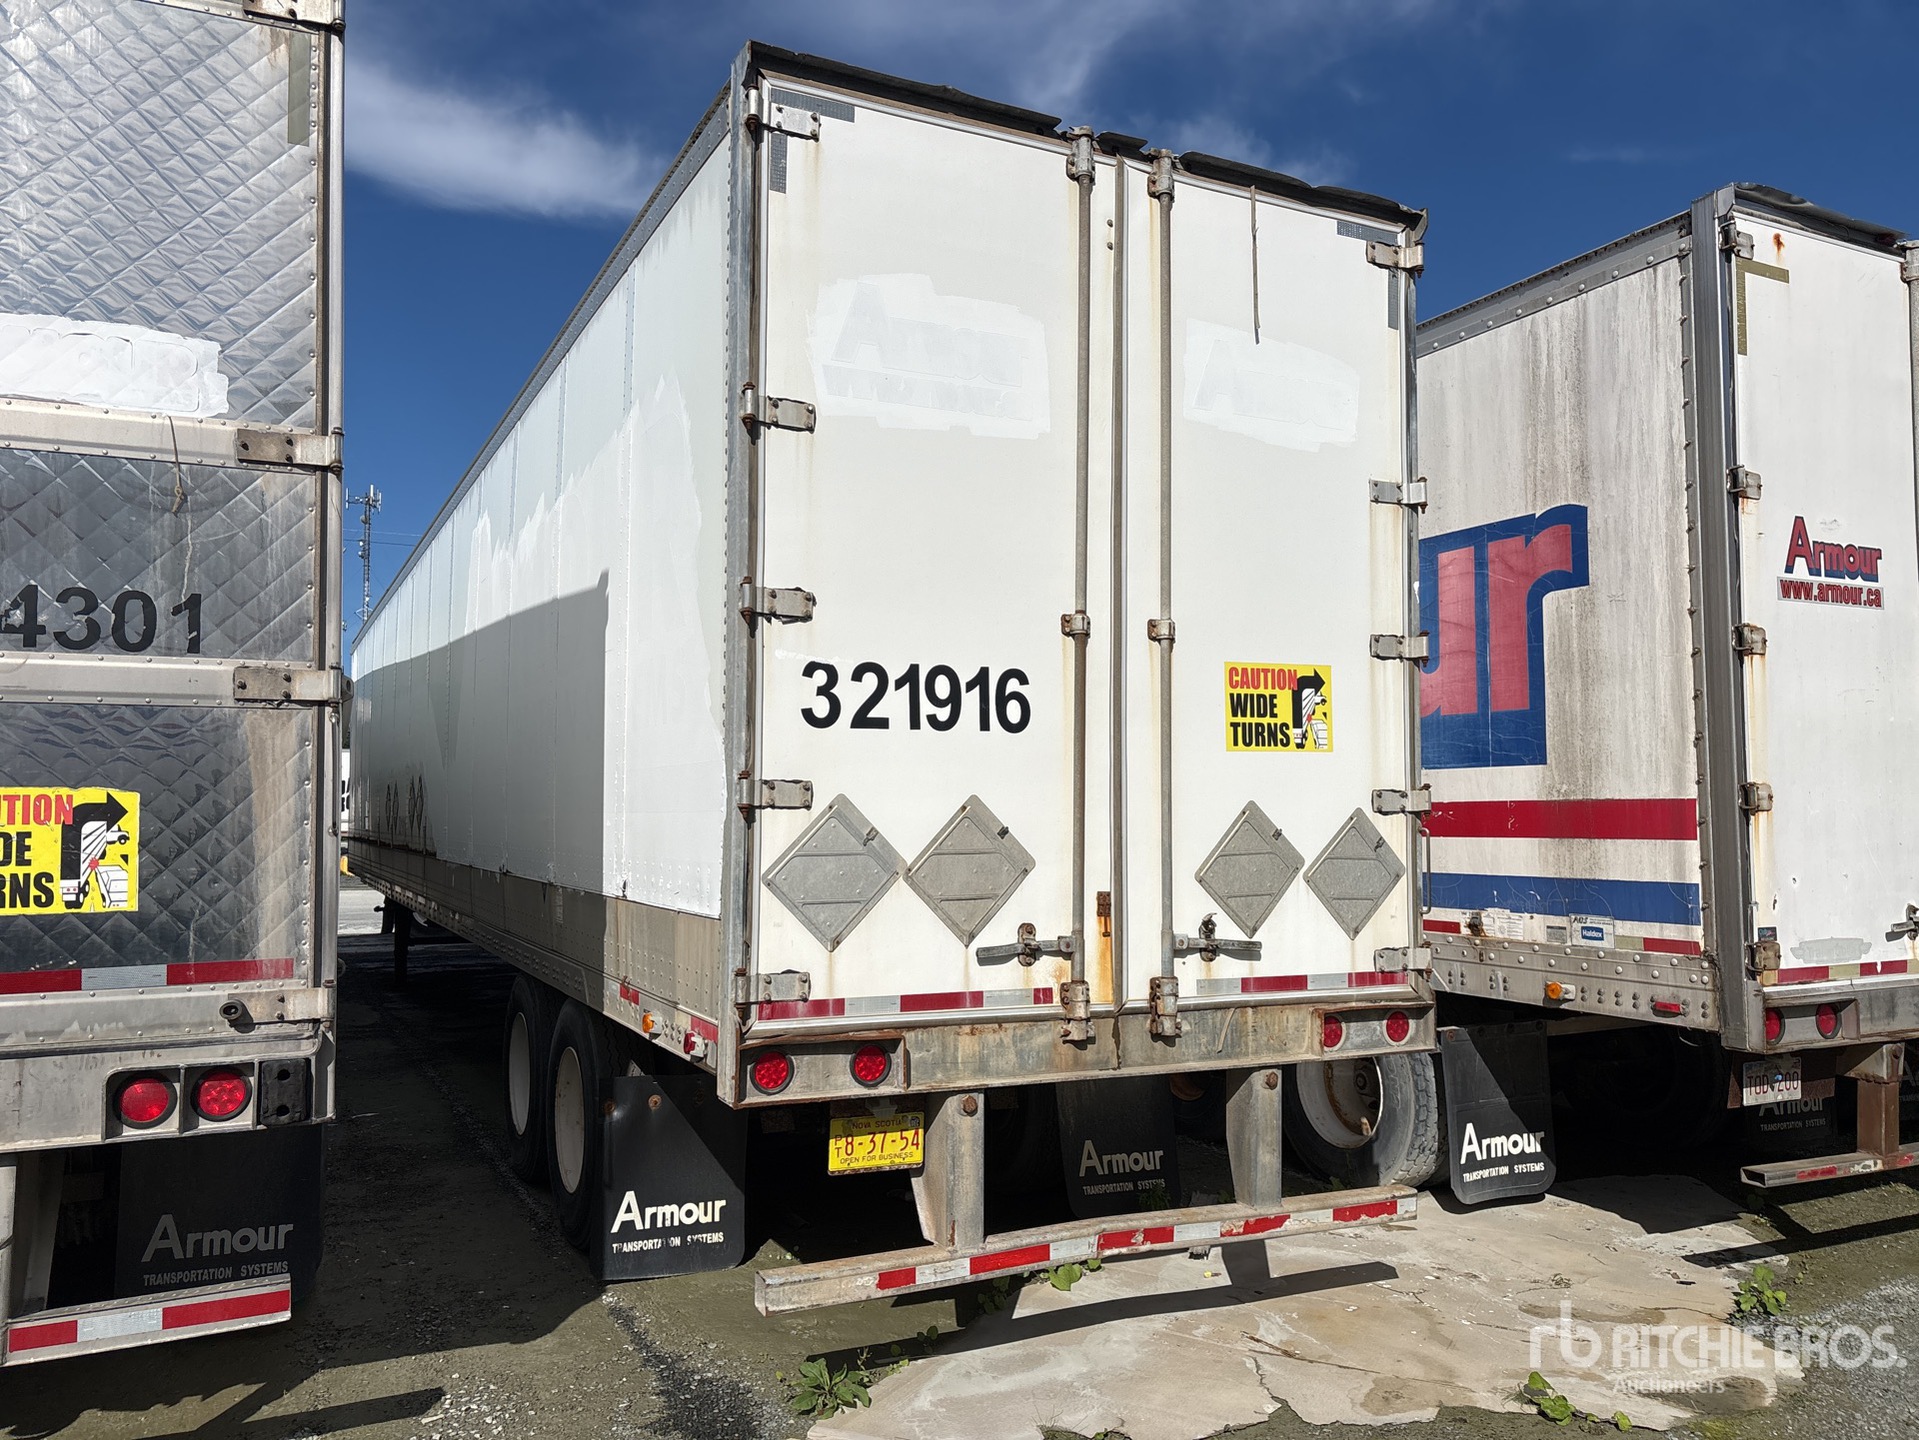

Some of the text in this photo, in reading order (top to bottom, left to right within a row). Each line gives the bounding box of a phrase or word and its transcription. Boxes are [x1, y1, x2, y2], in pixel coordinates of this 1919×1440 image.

[1783, 515, 1882, 583] Armour
[1780, 579, 1882, 608] www.armour.ca
[0, 584, 202, 654] 4301
[1228, 666, 1298, 691] CAUTION
[800, 660, 1031, 734] 321916
[1229, 692, 1278, 718] WIDE
[1229, 721, 1290, 748] TURNS
[0, 871, 54, 910] NS
[1777, 1071, 1799, 1092] 200
[852, 1122, 872, 1130] NOVA
[1760, 1117, 1826, 1132] TRANSPORTATION SYSTEMS
[844, 1127, 920, 1157] 8-37-54
[1460, 1122, 1545, 1165] Armour
[840, 1151, 914, 1165] OPEN FOR BUSINESS
[1079, 1139, 1164, 1177] Armour
[1463, 1161, 1545, 1183] TRANSPORTATION SYSTEMS
[1082, 1181, 1134, 1196] TRANSPORTATION
[610, 1190, 727, 1234] Armour
[141, 1213, 294, 1263] Armour
[143, 1260, 289, 1287] TRANSPORTATION SYSTEMS
